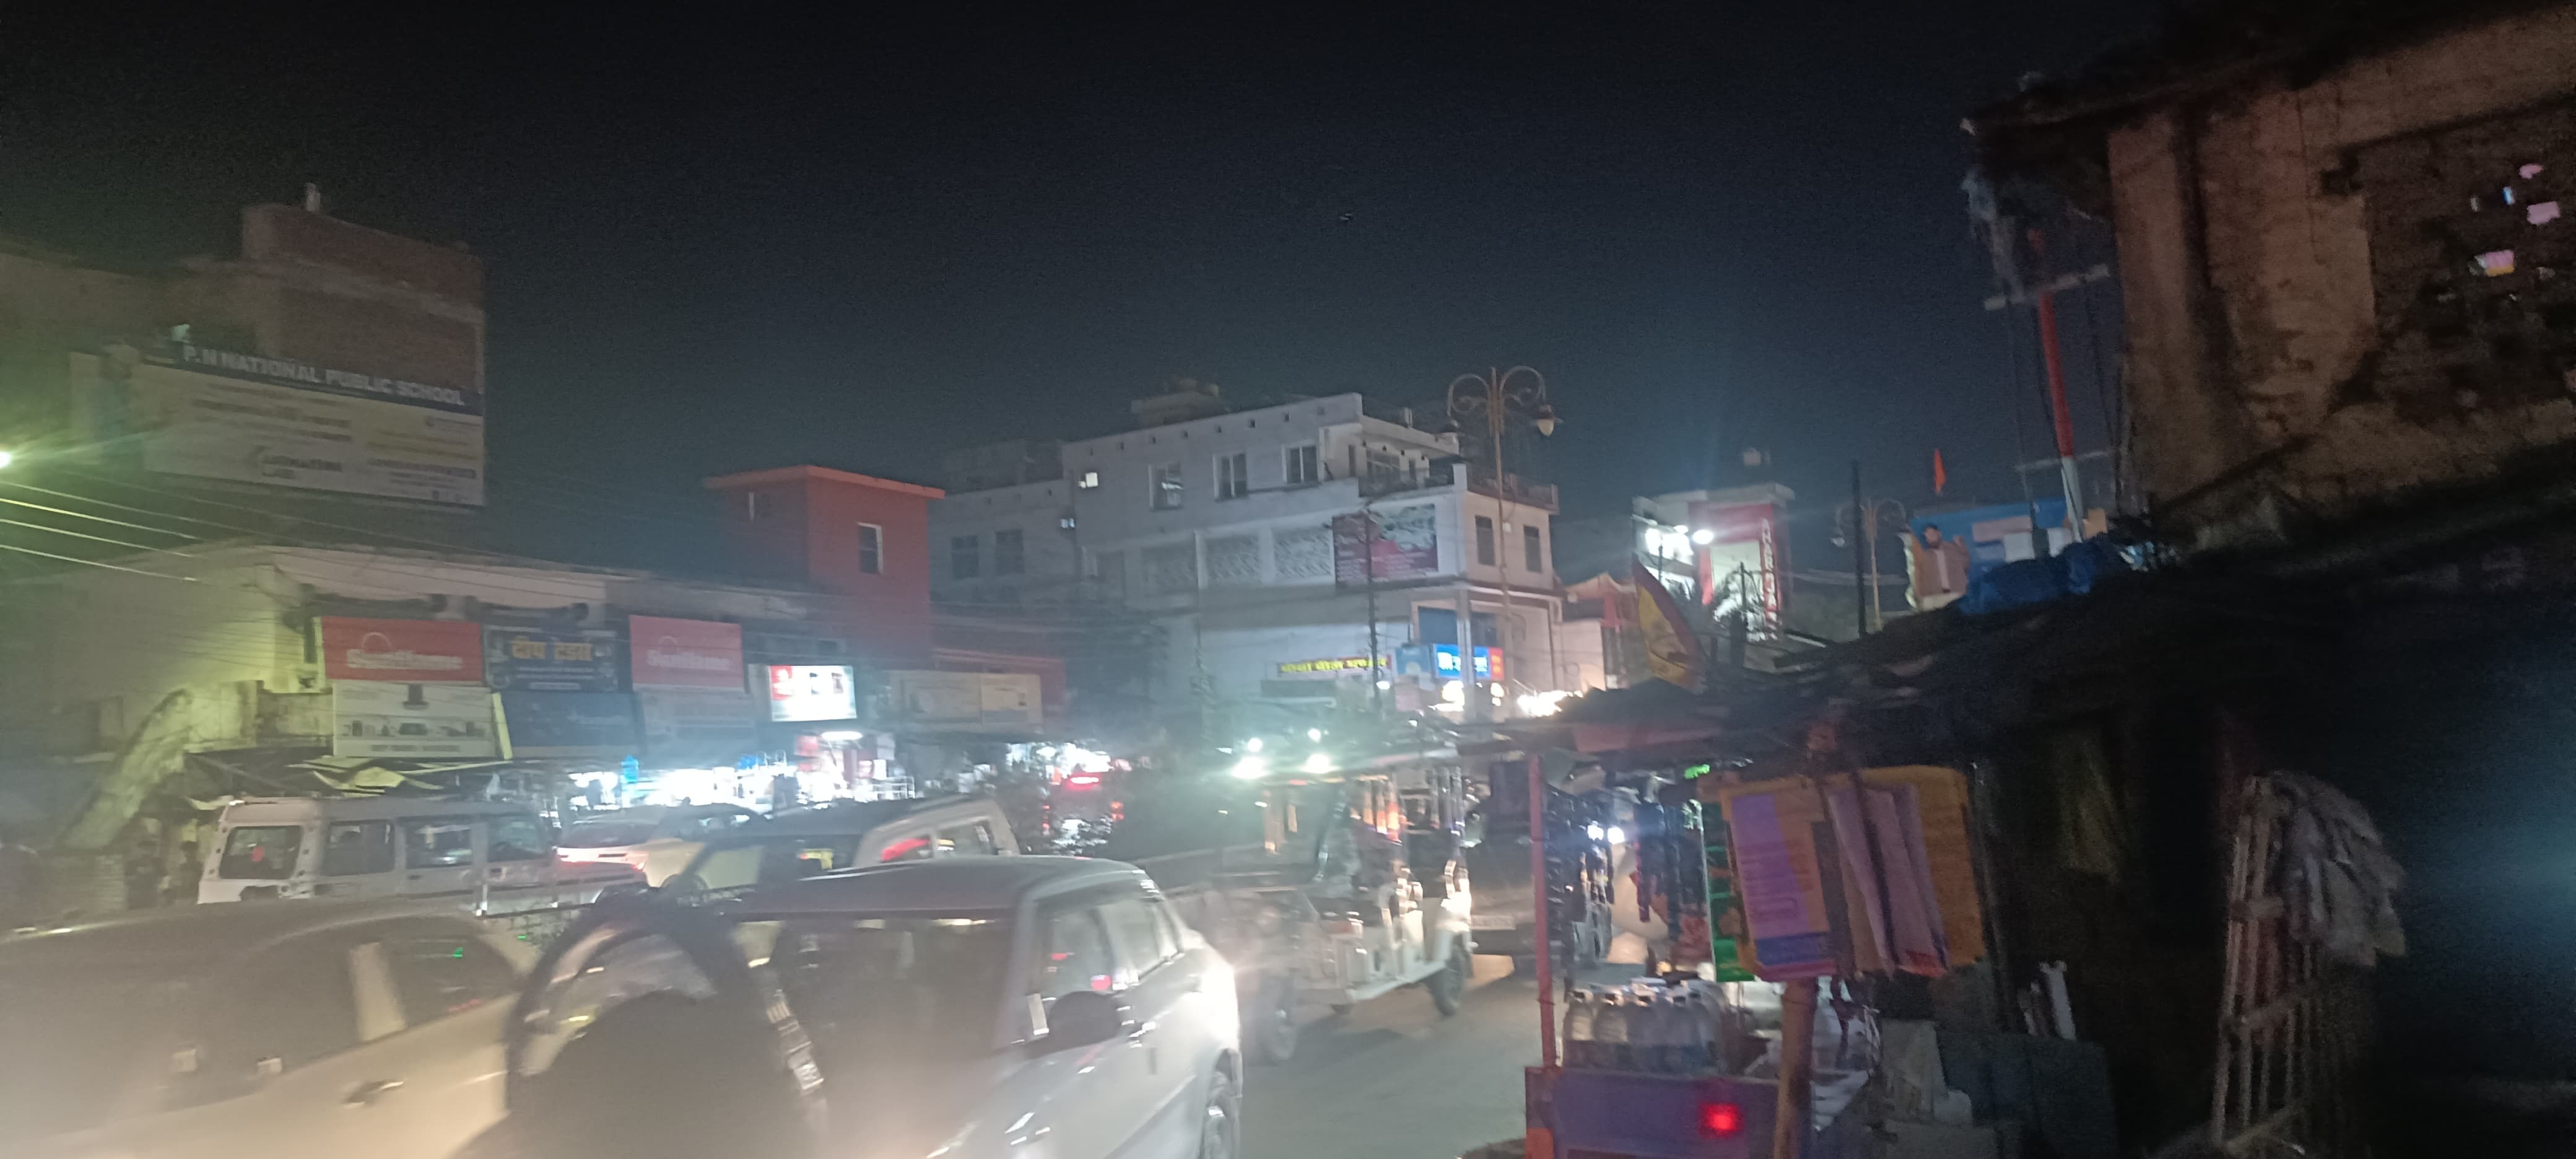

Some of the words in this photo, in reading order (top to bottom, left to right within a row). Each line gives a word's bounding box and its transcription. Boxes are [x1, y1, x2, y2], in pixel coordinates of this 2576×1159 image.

[221, 351, 321, 383] NATIONAL
[326, 369, 393, 394] PUBLIC
[395, 379, 465, 406] SCHOOL
